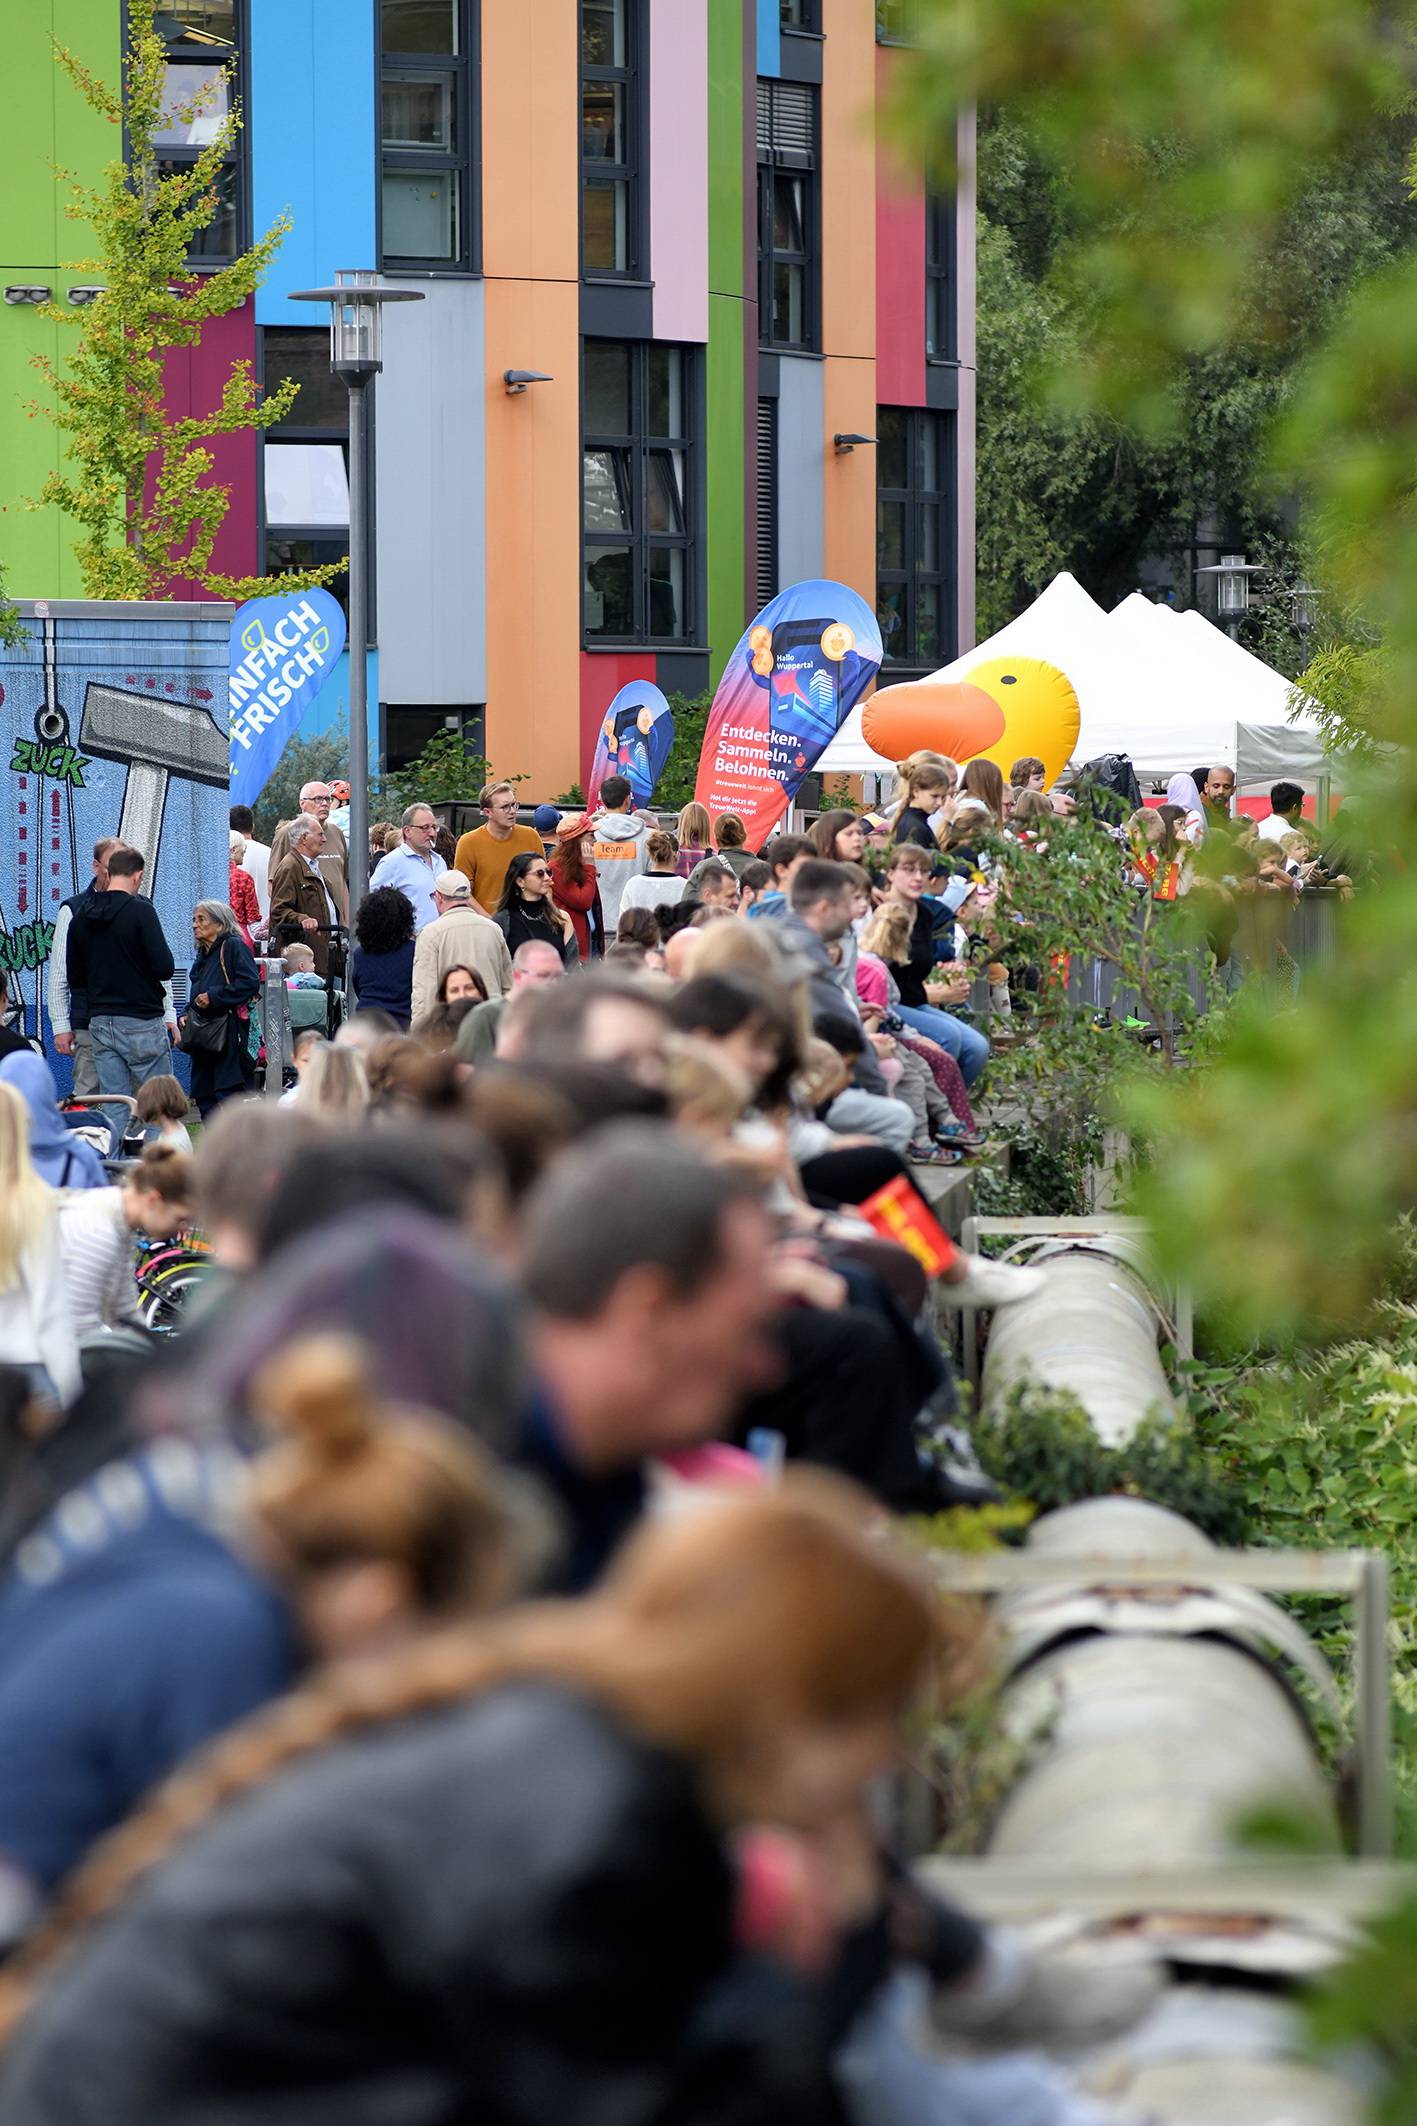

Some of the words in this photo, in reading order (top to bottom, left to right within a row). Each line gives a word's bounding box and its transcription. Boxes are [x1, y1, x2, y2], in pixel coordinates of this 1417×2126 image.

[229, 600, 321, 719] INFACH
[776, 660, 814, 671] Wuppertal
[230, 640, 325, 750] FRISCH
[720, 723, 801, 747] Entdecken.
[10, 737, 92, 788] ZUCK
[717, 740, 792, 764] Sammeln.
[714, 757, 789, 781] Belohnen.
[710, 793, 721, 801] Hol
[600, 844, 625, 854] Team
